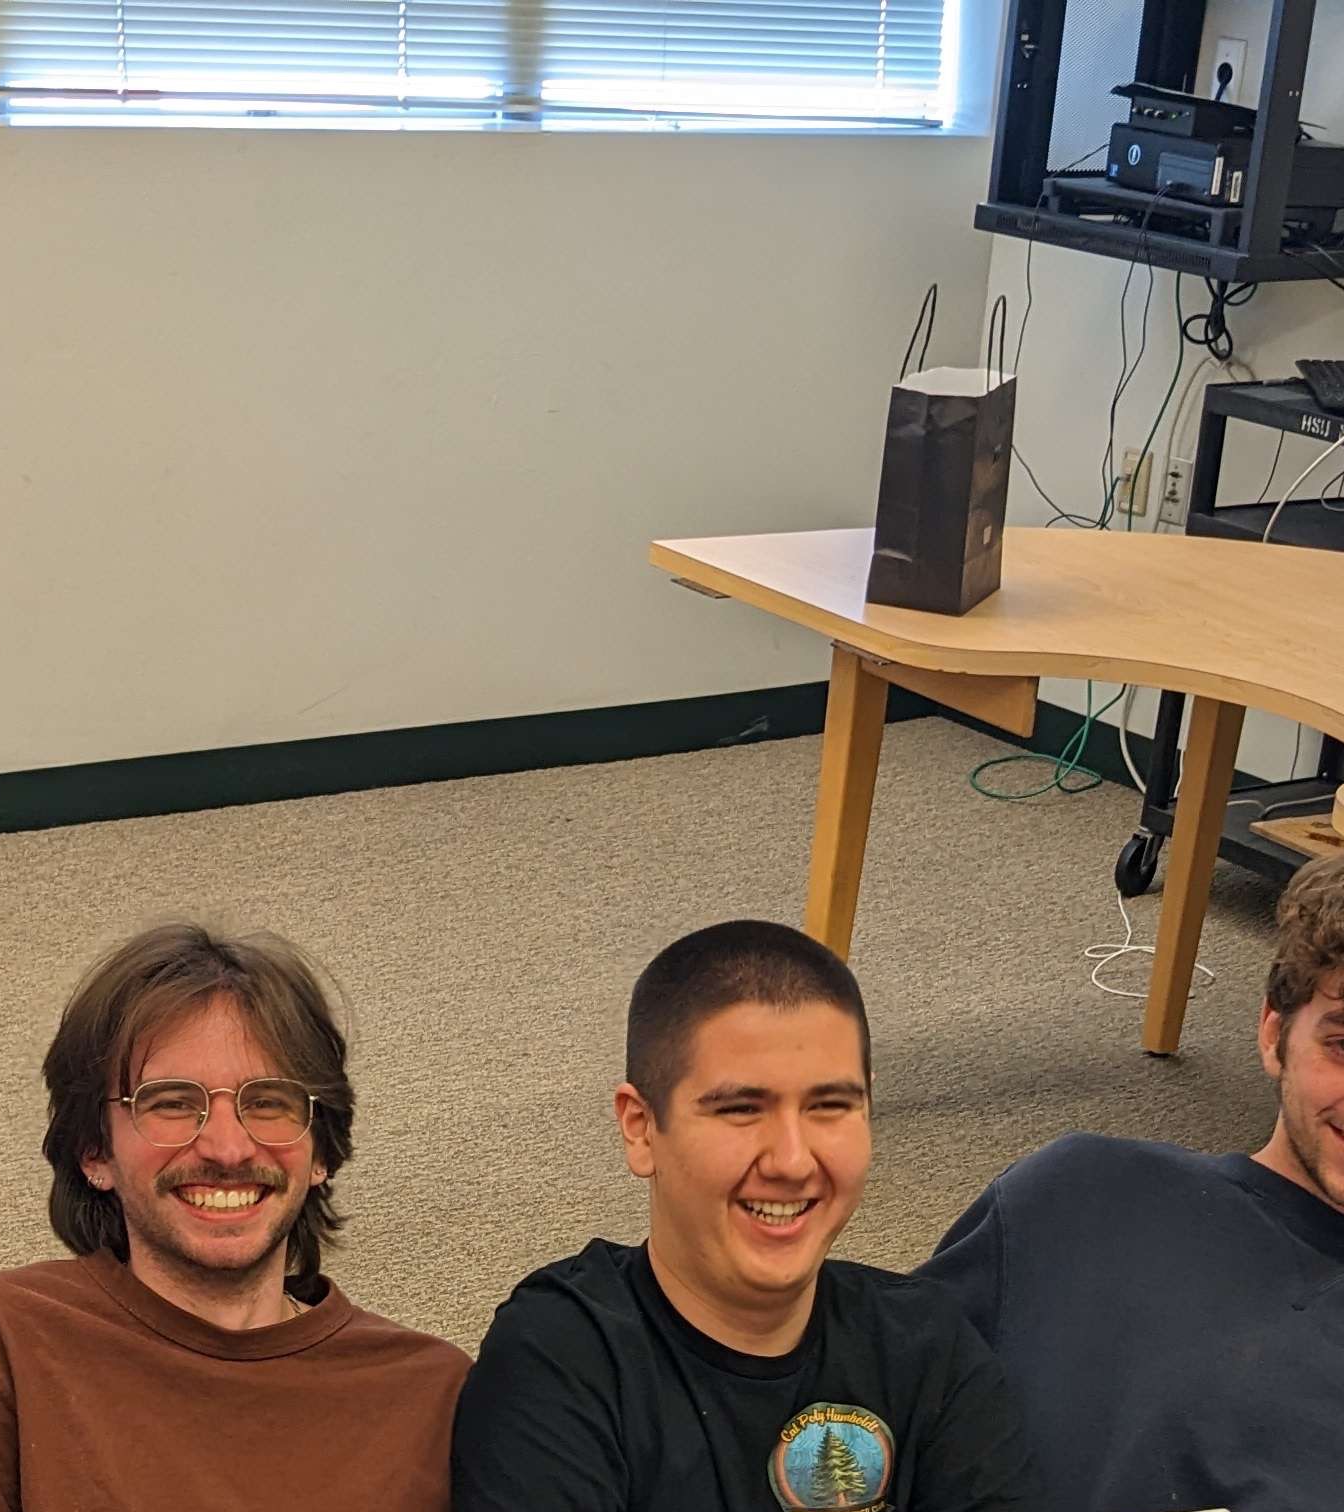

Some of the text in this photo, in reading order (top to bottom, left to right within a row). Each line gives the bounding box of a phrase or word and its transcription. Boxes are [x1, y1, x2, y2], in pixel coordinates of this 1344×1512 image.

[1300, 414, 1331, 437] HSU
[780, 1407, 879, 1442] Cal Poly Humboldt
